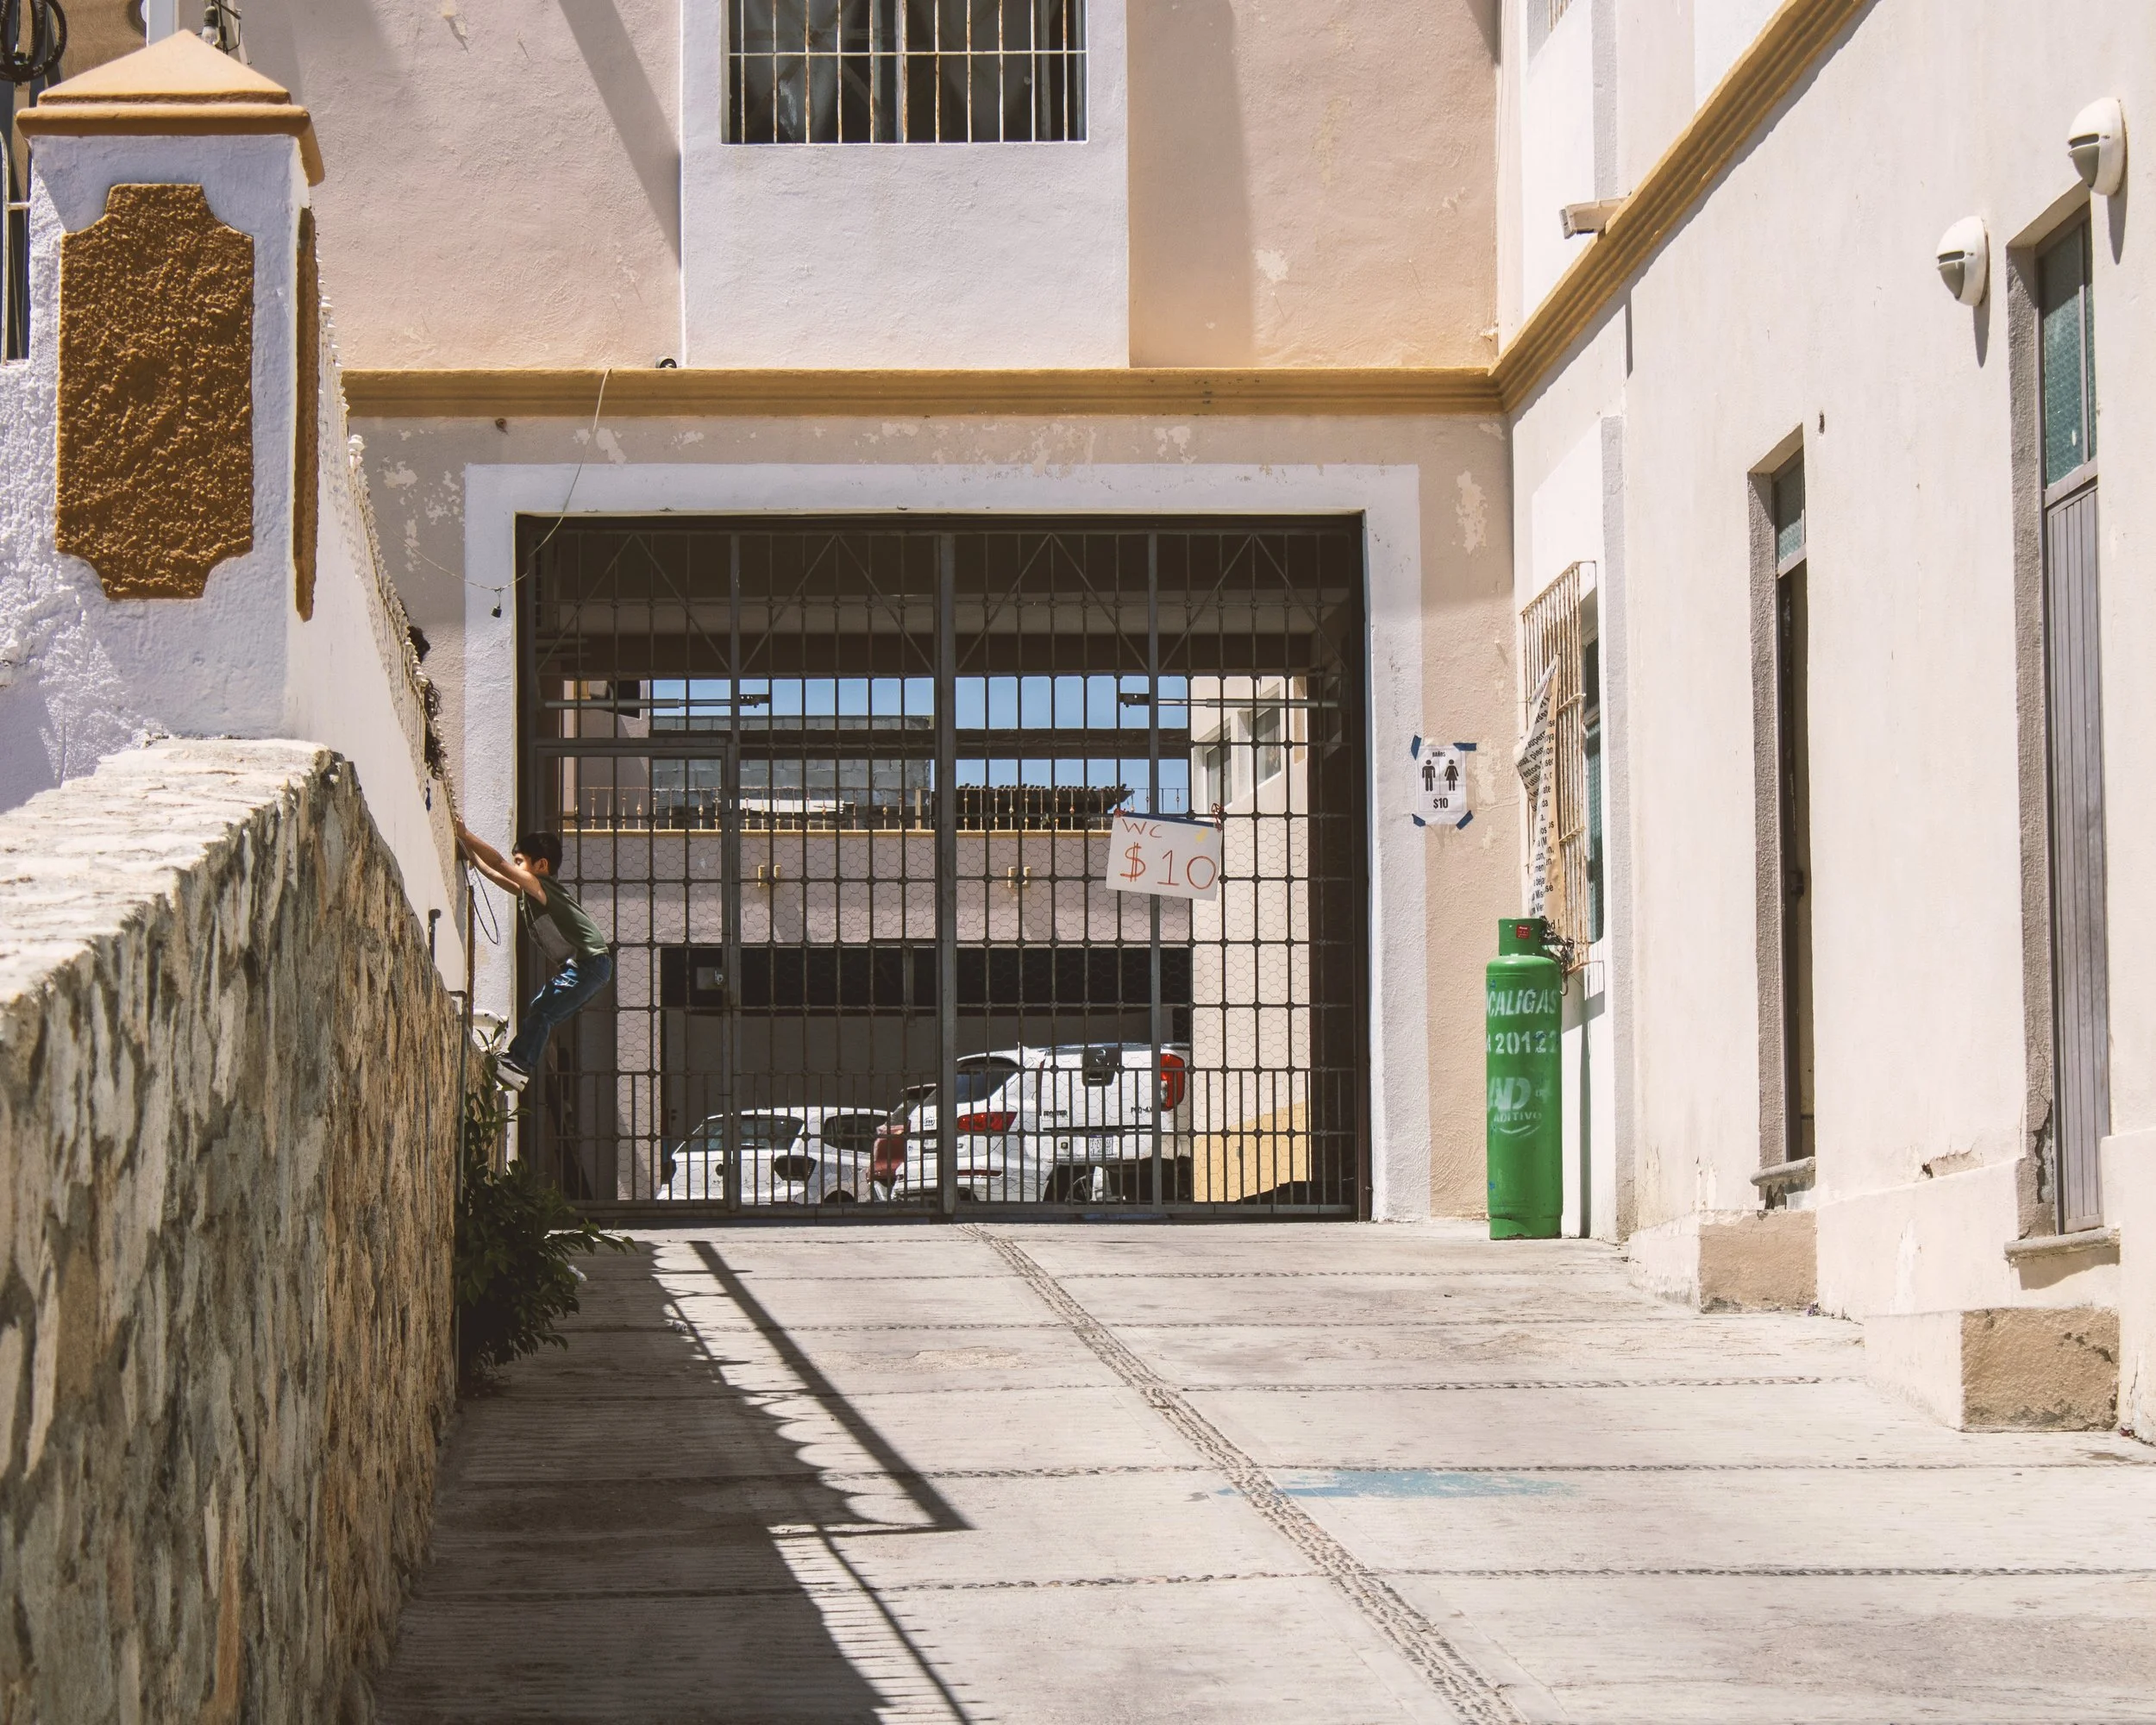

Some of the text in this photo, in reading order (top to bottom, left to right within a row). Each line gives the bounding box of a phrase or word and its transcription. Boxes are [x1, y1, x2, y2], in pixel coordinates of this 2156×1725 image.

[1433, 798, 1449, 809] $10
[1122, 818, 1163, 838] WC
[1119, 842, 1217, 890] $10
[1487, 989, 1558, 1017] CALIGAS
